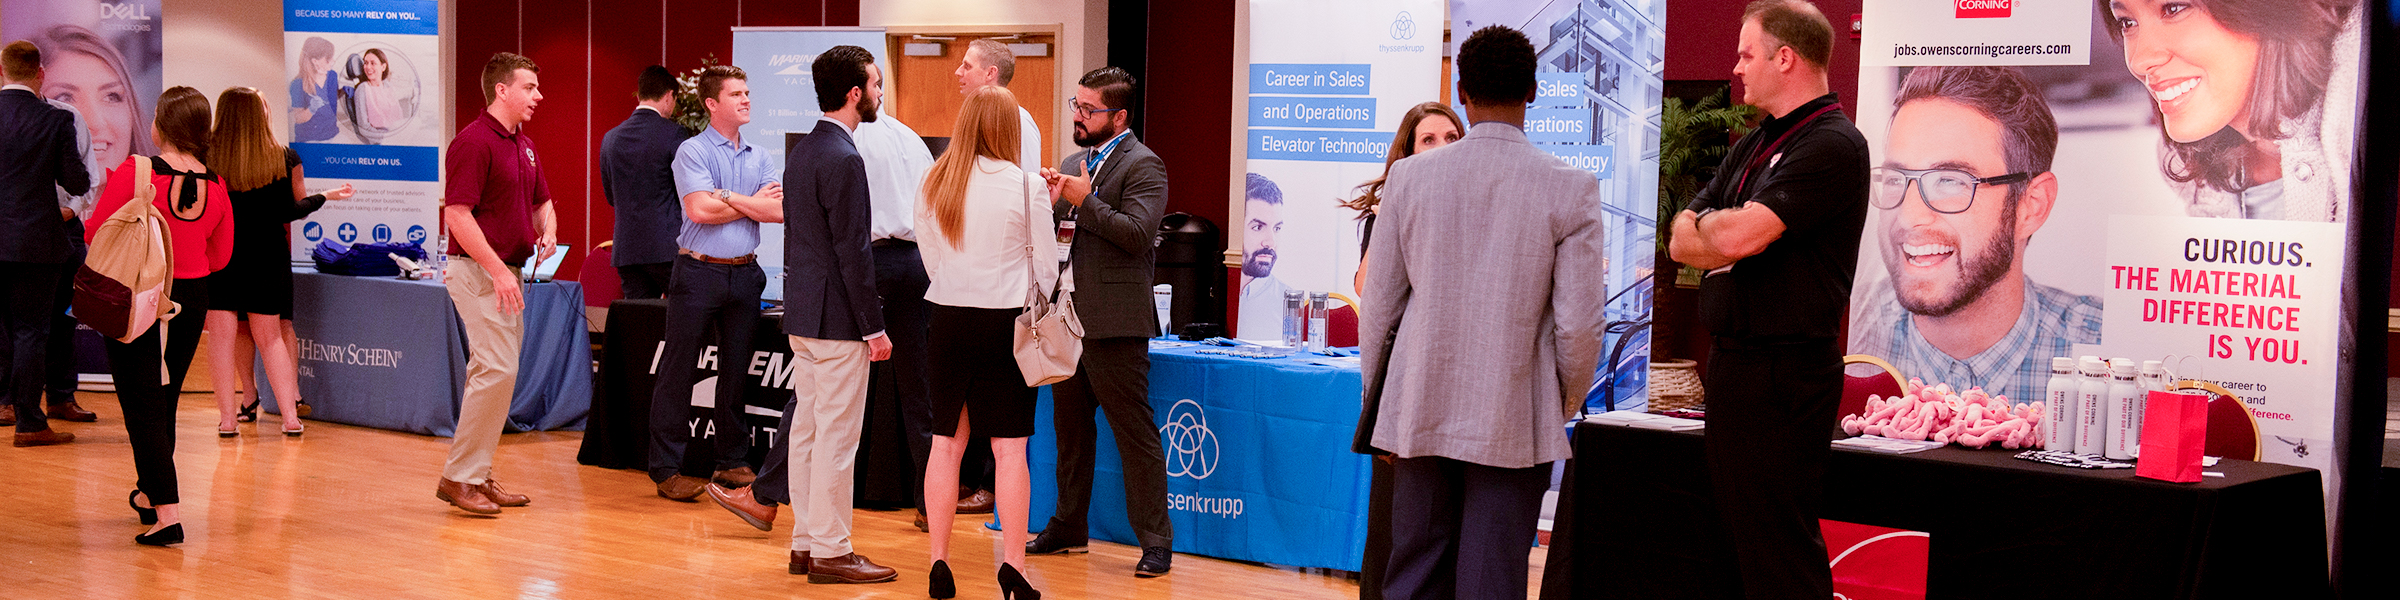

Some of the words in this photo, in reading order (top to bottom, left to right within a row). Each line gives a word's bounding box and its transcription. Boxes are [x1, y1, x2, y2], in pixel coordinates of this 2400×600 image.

[100, 2, 151, 20] DELL
[1959, 0, 2009, 9] CORNING
[295, 10, 329, 18] BECAUSE
[331, 10, 341, 18] SO
[343, 10, 365, 18] MANY
[366, 11, 384, 19] RELY
[399, 12, 421, 20] YOU...
[1379, 44, 1425, 53] thyssenkrupp
[1894, 43, 2071, 58] jobs.owenscorningcareers.com
[1265, 70, 1310, 87] Career
[1313, 71, 1325, 87] in
[1329, 71, 1365, 87] Sales
[1537, 80, 1578, 97] Sales
[1263, 104, 1289, 119] and
[1294, 104, 1370, 123] Operations
[1524, 117, 1583, 133] erations
[1261, 136, 1315, 152] Elevator
[1319, 137, 1392, 158] Technology
[358, 157, 376, 166] RELY
[377, 158, 389, 166] ON
[2184, 237, 2312, 267] CURIOUS.
[2111, 265, 2160, 292] THE
[2169, 268, 2302, 300] MATERIAL
[2142, 298, 2300, 332] DIFFERENCE
[301, 339, 346, 364] HENRY
[347, 343, 398, 369] SCHEIN
[2208, 334, 2233, 360] IS
[2244, 336, 2308, 366] YOU.
[297, 365, 315, 378] NTAL
[2221, 380, 2254, 391] career
[2256, 382, 2267, 392] to
[2246, 394, 2266, 405] and
[1167, 492, 1243, 519] senkrupp
